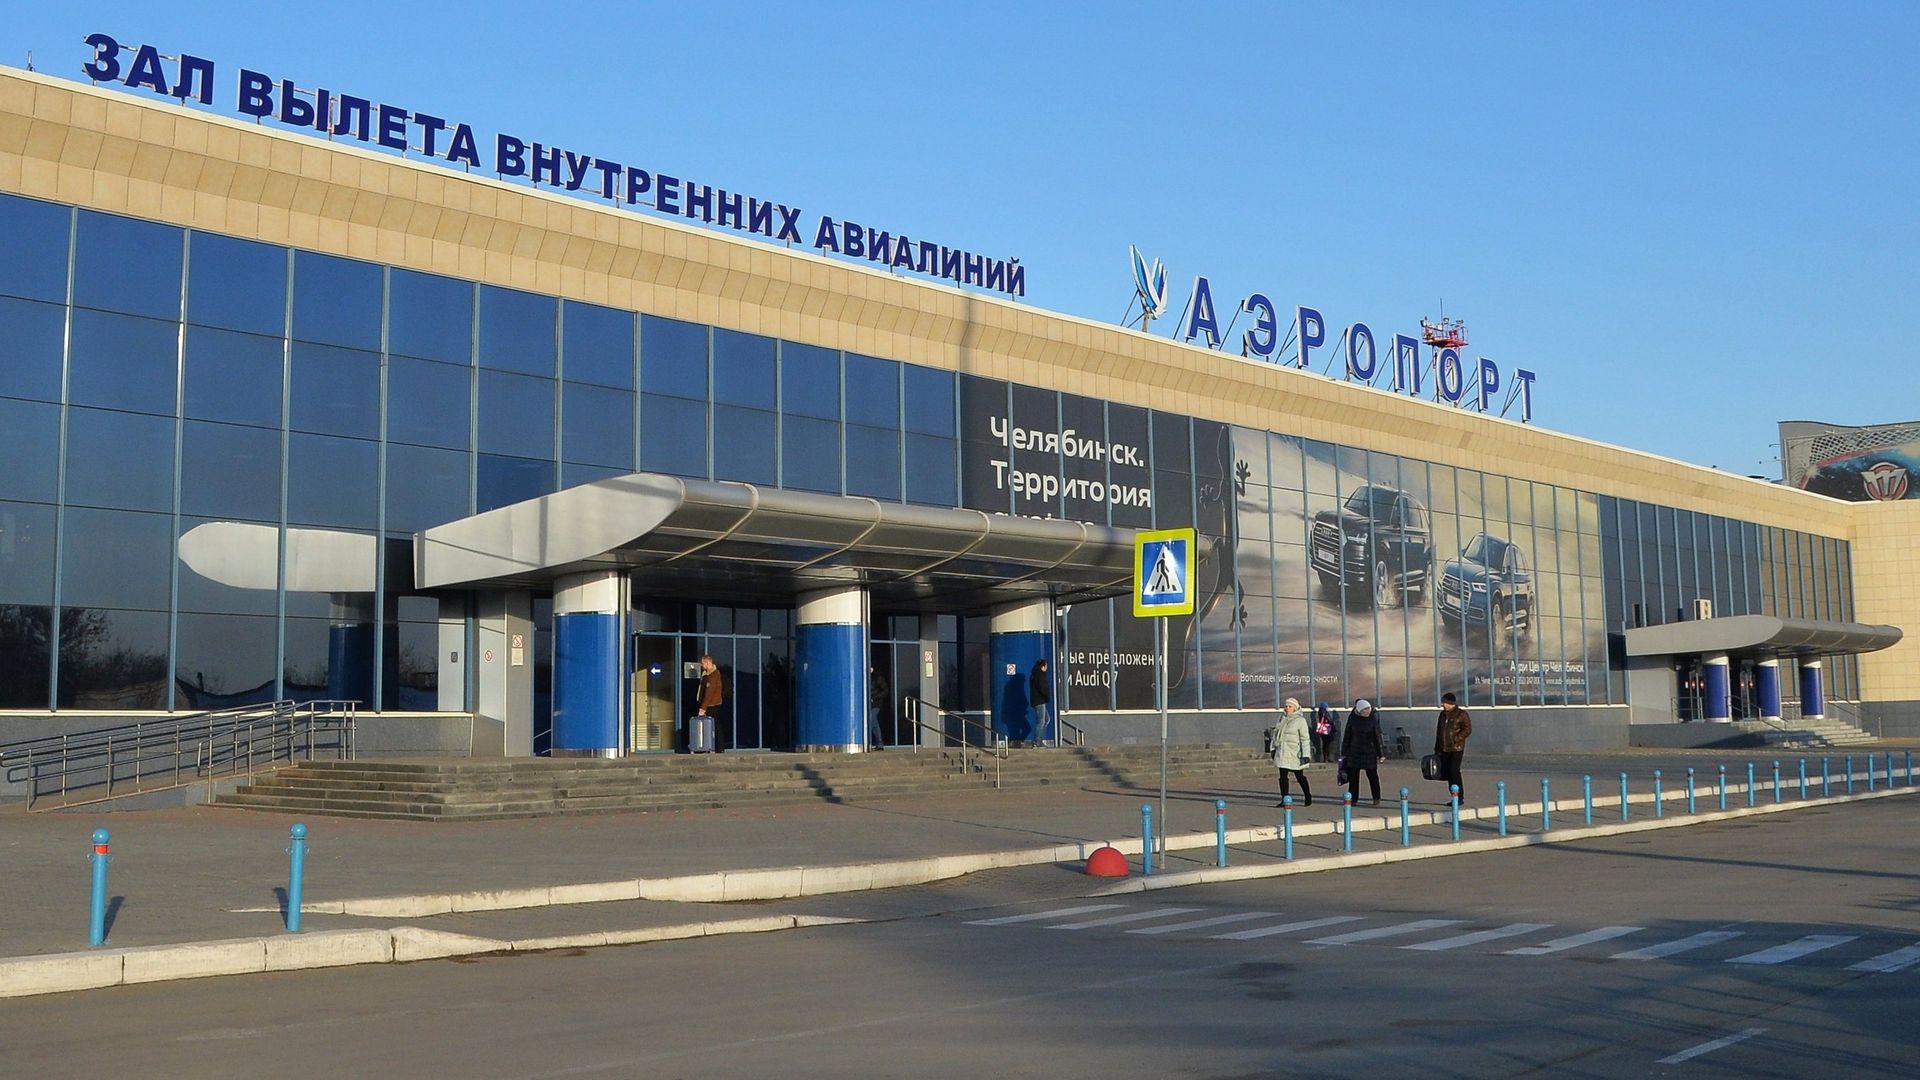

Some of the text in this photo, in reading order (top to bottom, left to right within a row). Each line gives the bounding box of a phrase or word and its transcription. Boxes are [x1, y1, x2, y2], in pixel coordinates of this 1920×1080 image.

[83, 33, 1026, 297] ЗАЛ ВЫЛЕТА ВНУТРЕННИХ АВИАЛИНИЙ
[1185, 275, 1537, 424] АЭРОПОРТ
[990, 416, 1145, 468] Челябинск.
[990, 459, 1152, 508] Территория
[1075, 670, 1100, 687] Audi
